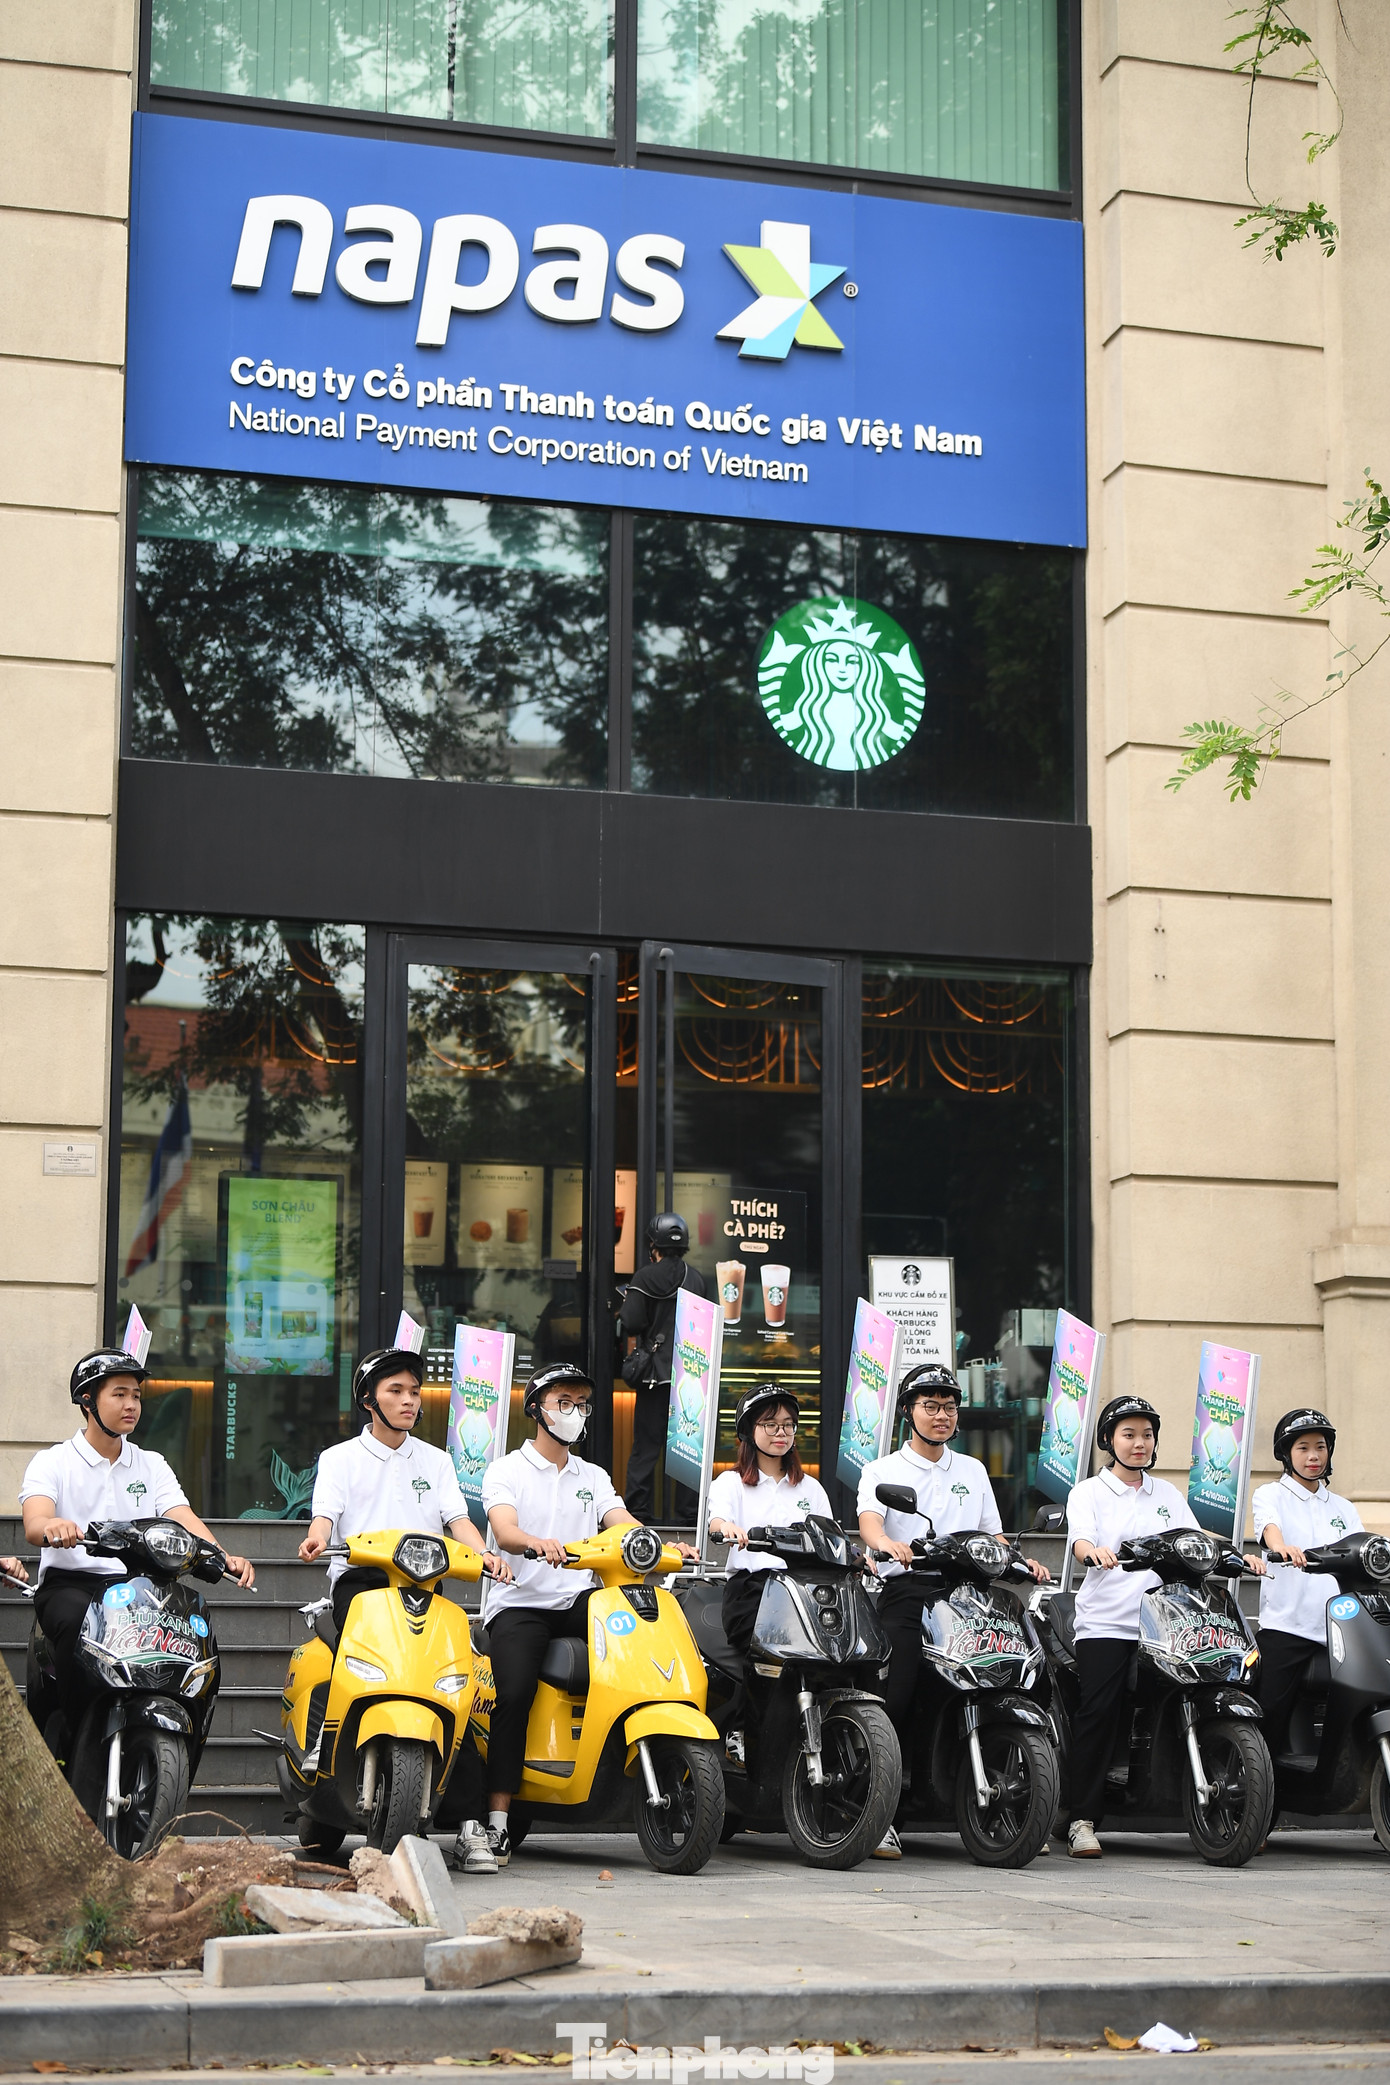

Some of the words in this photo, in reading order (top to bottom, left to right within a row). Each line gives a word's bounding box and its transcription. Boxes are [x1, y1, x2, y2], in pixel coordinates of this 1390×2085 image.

[231, 195, 686, 348] napas
[230, 356, 317, 398] Công
[323, 367, 355, 401] ty
[363, 363, 410, 400] Cổ
[416, 377, 493, 409] phần
[499, 383, 595, 420] Thanh
[603, 395, 674, 426] toán
[685, 402, 770, 436] Quốc
[781, 413, 827, 445] gia
[838, 416, 902, 453] Việt
[914, 423, 983, 456] Nam
[229, 401, 345, 439] National
[356, 413, 477, 451] Payment
[487, 425, 656, 468] Corporation
[663, 446, 691, 472] of
[701, 446, 809, 483] Vietnam
[252, 1200, 278, 1211] SƠN
[730, 1198, 778, 1218] THÍCH
[723, 1218, 745, 1237] CÀ
[748, 1221, 786, 1240] PHÊ?
[886, 1309, 914, 1317] KHÁCH
[916, 1309, 939, 1318] HÀNG
[909, 1328, 931, 1336] LÒNG
[855, 1352, 874, 1372] THANH
[1055, 1362, 1075, 1382] THANH
[457, 1381, 480, 1394] THANH
[1202, 1394, 1226, 1408] THANH
[225, 1382, 237, 1460] STARBUCKS
[1201, 1488, 1229, 1504] 5-6/10/2024
[109, 1589, 130, 1603] 13
[1333, 1600, 1355, 1616] 09
[118, 1607, 152, 1626] PHỦ
[155, 1612, 196, 1639] XANH
[193, 1618, 206, 1632] 13
[610, 1615, 632, 1631] 01
[952, 1613, 983, 1633] PHỦ
[986, 1617, 1022, 1636] XANH
[1171, 1610, 1202, 1631] PHỦ
[1203, 1613, 1239, 1631] XANH
[150, 1627, 198, 1656] Nam
[982, 1630, 1028, 1654] Nam
[1203, 1626, 1246, 1649] Nam
